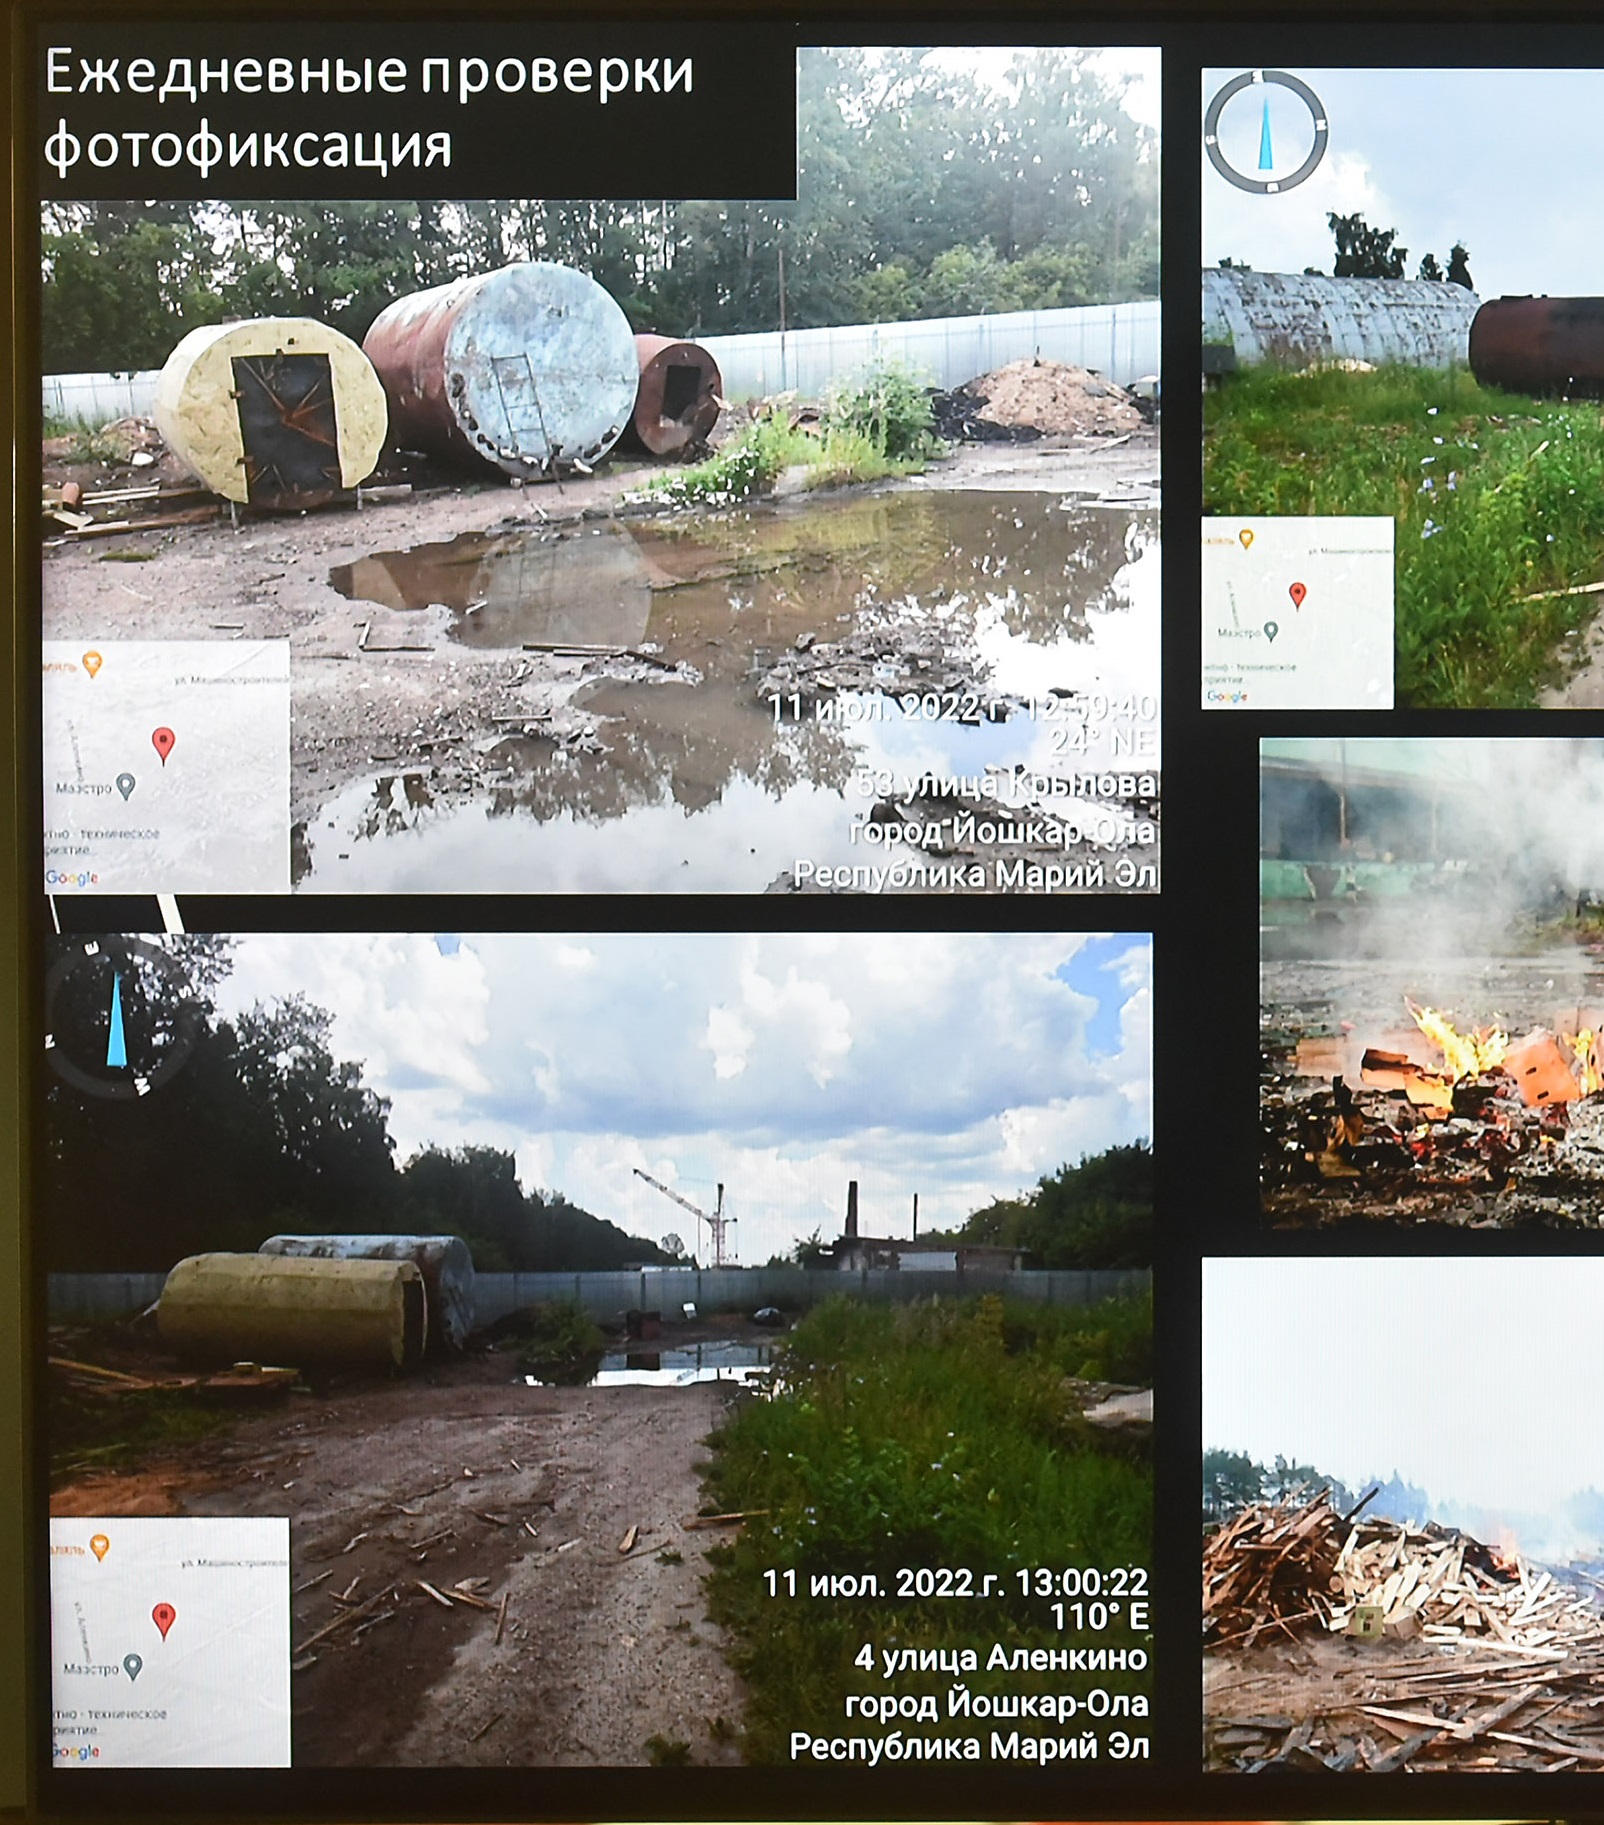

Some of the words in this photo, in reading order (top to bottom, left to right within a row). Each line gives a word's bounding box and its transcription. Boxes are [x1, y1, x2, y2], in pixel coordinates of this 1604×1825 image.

[45, 46, 407, 103] Ежедневные
[423, 55, 694, 104] проверки
[43, 117, 453, 179] фотофиксация
[767, 694, 802, 722] 11
[814, 698, 892, 722] июл.
[901, 694, 981, 722] 2022
[1027, 694, 1157, 722] 12:59:40
[1110, 728, 1157, 757] NE
[856, 769, 894, 798] 53
[903, 774, 998, 804] улица
[1008, 769, 1157, 804] Крылова
[849, 821, 943, 849] город
[953, 811, 1156, 849] Йошкар-Ола
[46, 869, 99, 887] Google
[794, 859, 986, 893] Республика
[996, 859, 1104, 893] Марий
[1115, 860, 1157, 888] Эл
[763, 1569, 797, 1597] 11
[810, 1573, 886, 1597] июл.
[895, 1569, 974, 1597] 2022
[983, 1573, 1006, 1597] г.
[1016, 1568, 1149, 1597] 13:00:22
[1050, 1602, 1120, 1630] 110°
[1130, 1602, 1150, 1630] E
[854, 1644, 875, 1671] 4
[882, 1649, 978, 1678] улица
[986, 1644, 1148, 1671] Аленкино
[845, 1695, 939, 1724] город
[948, 1684, 1149, 1724] Йошкар-Ола
[790, 1731, 981, 1767] Республика
[990, 1731, 1099, 1767] Марий
[1107, 1732, 1150, 1760] Эл
